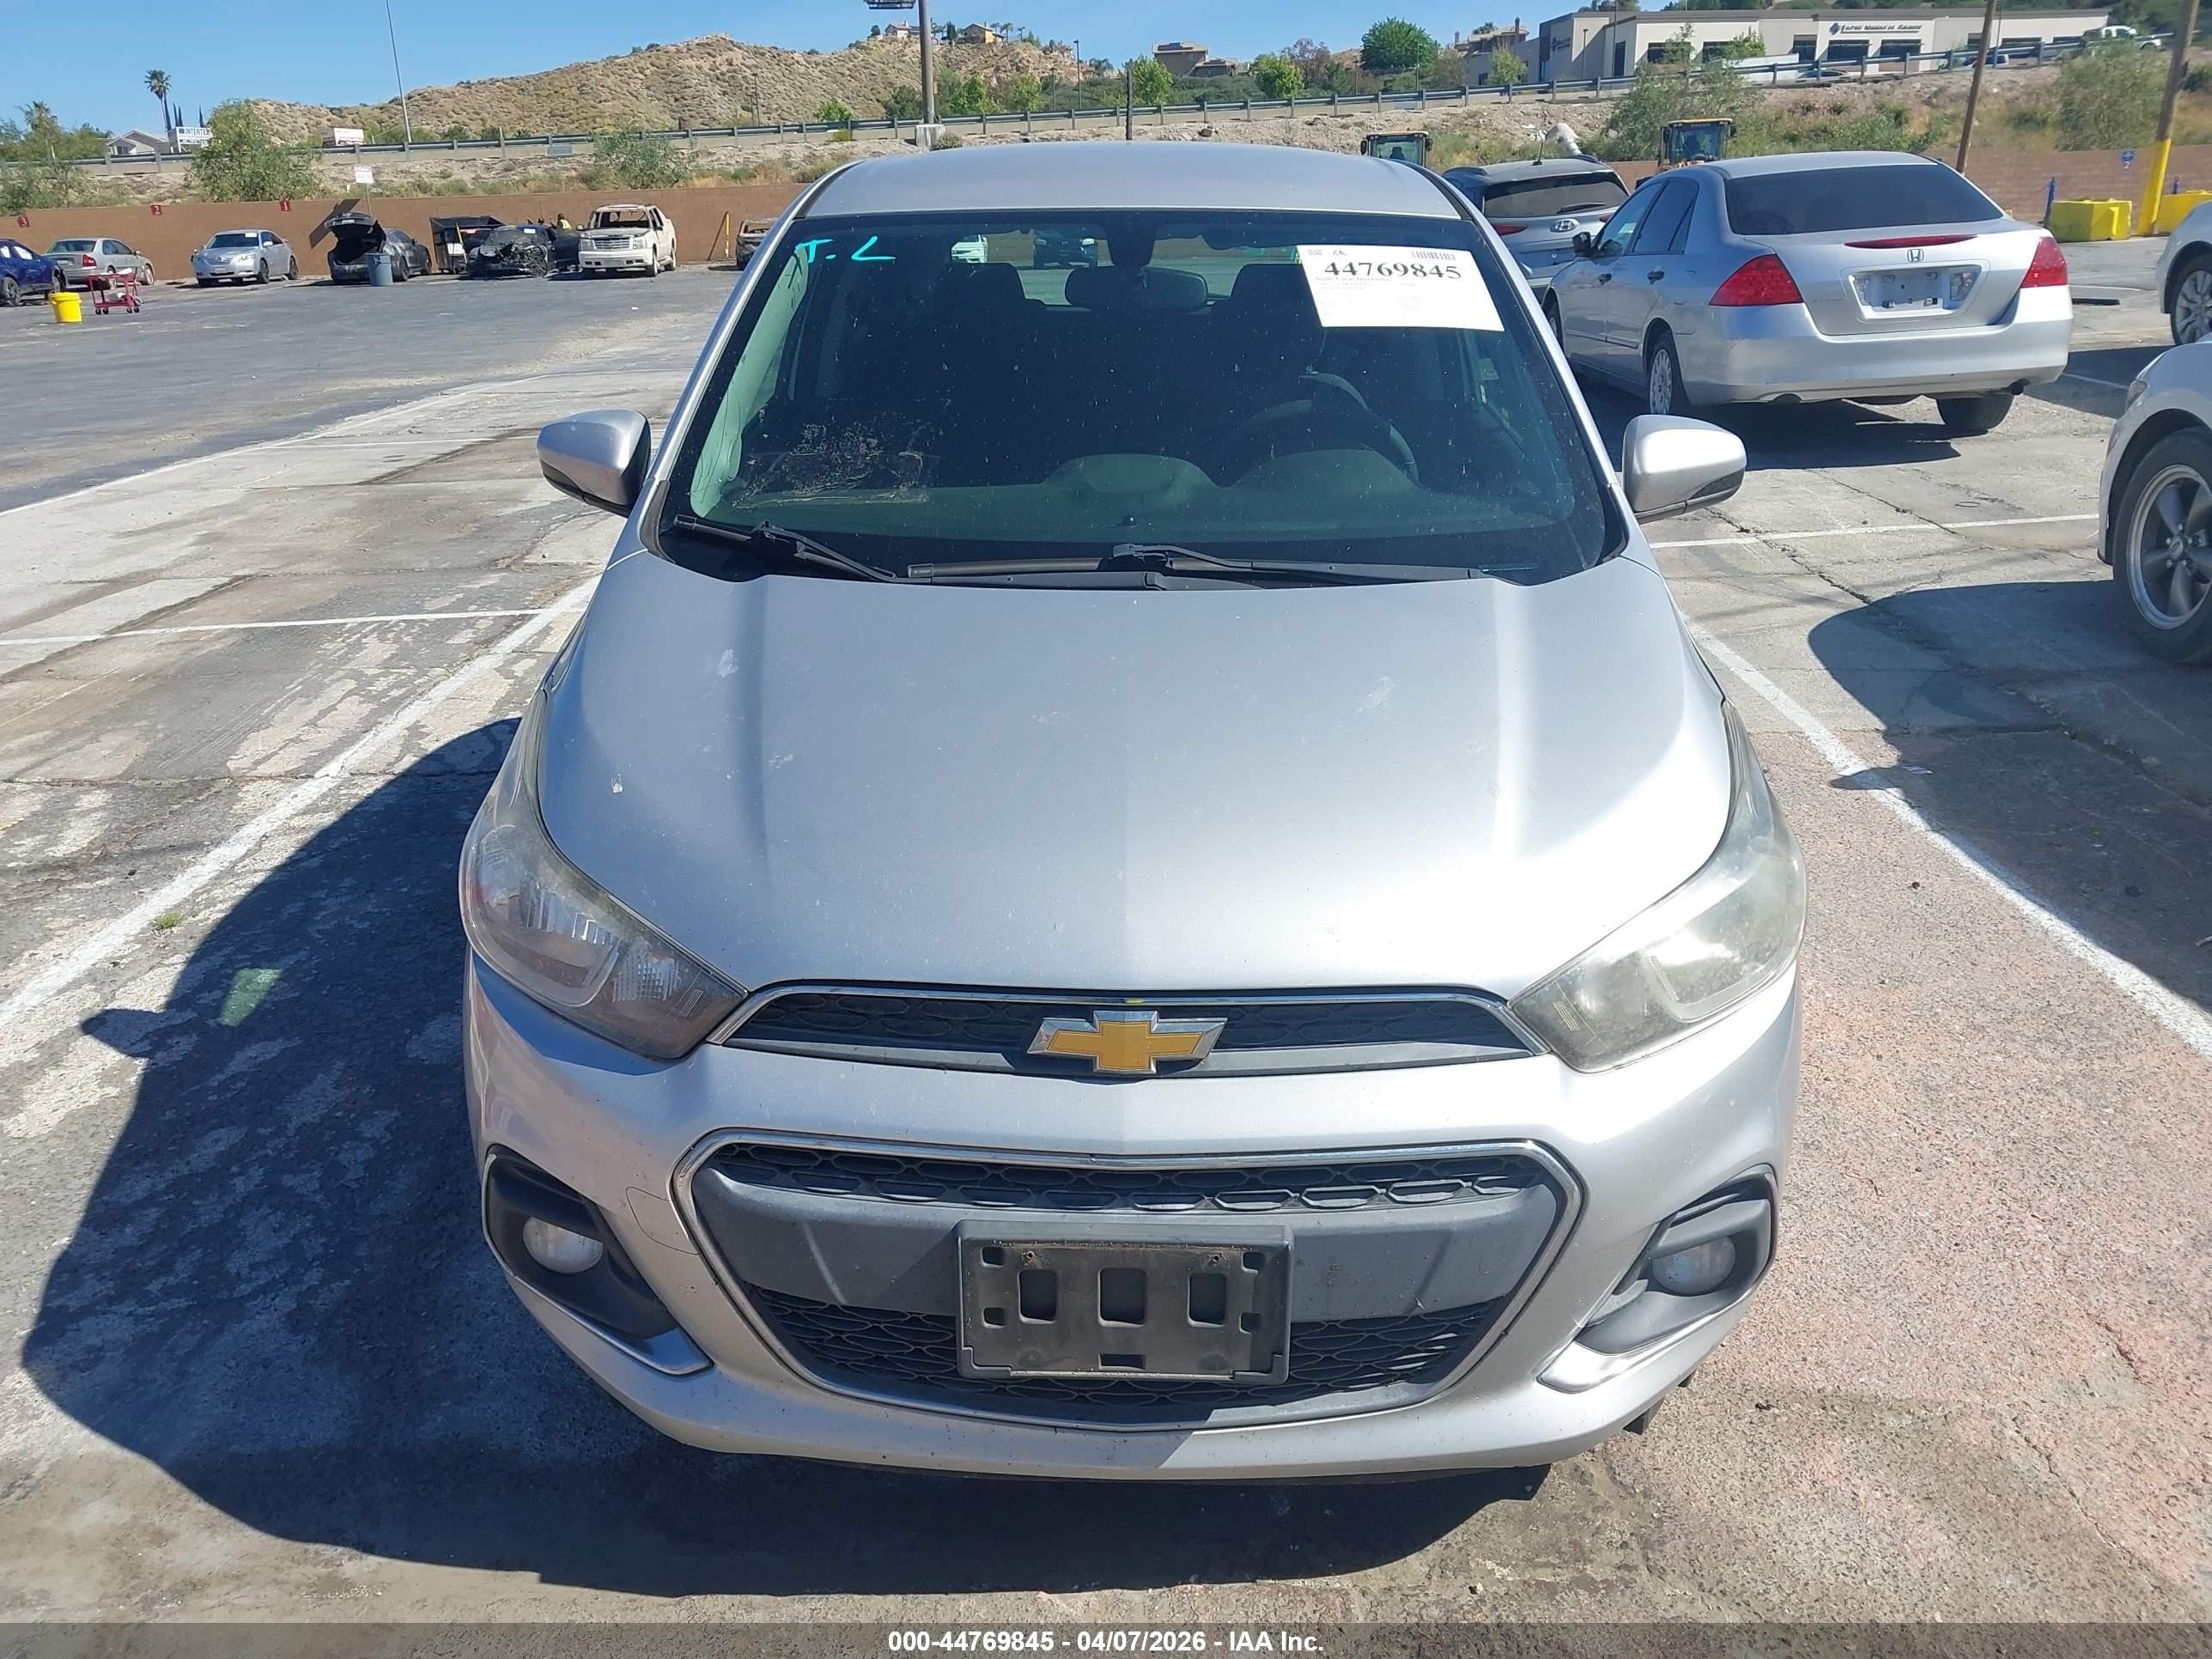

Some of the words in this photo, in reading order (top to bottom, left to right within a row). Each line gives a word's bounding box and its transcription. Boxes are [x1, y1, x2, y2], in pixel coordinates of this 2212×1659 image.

[2123, 161, 2130, 169] 2
[154, 205, 161, 215] 2
[21, 217, 27, 227] 3
[1324, 262, 1462, 280] 44769845
